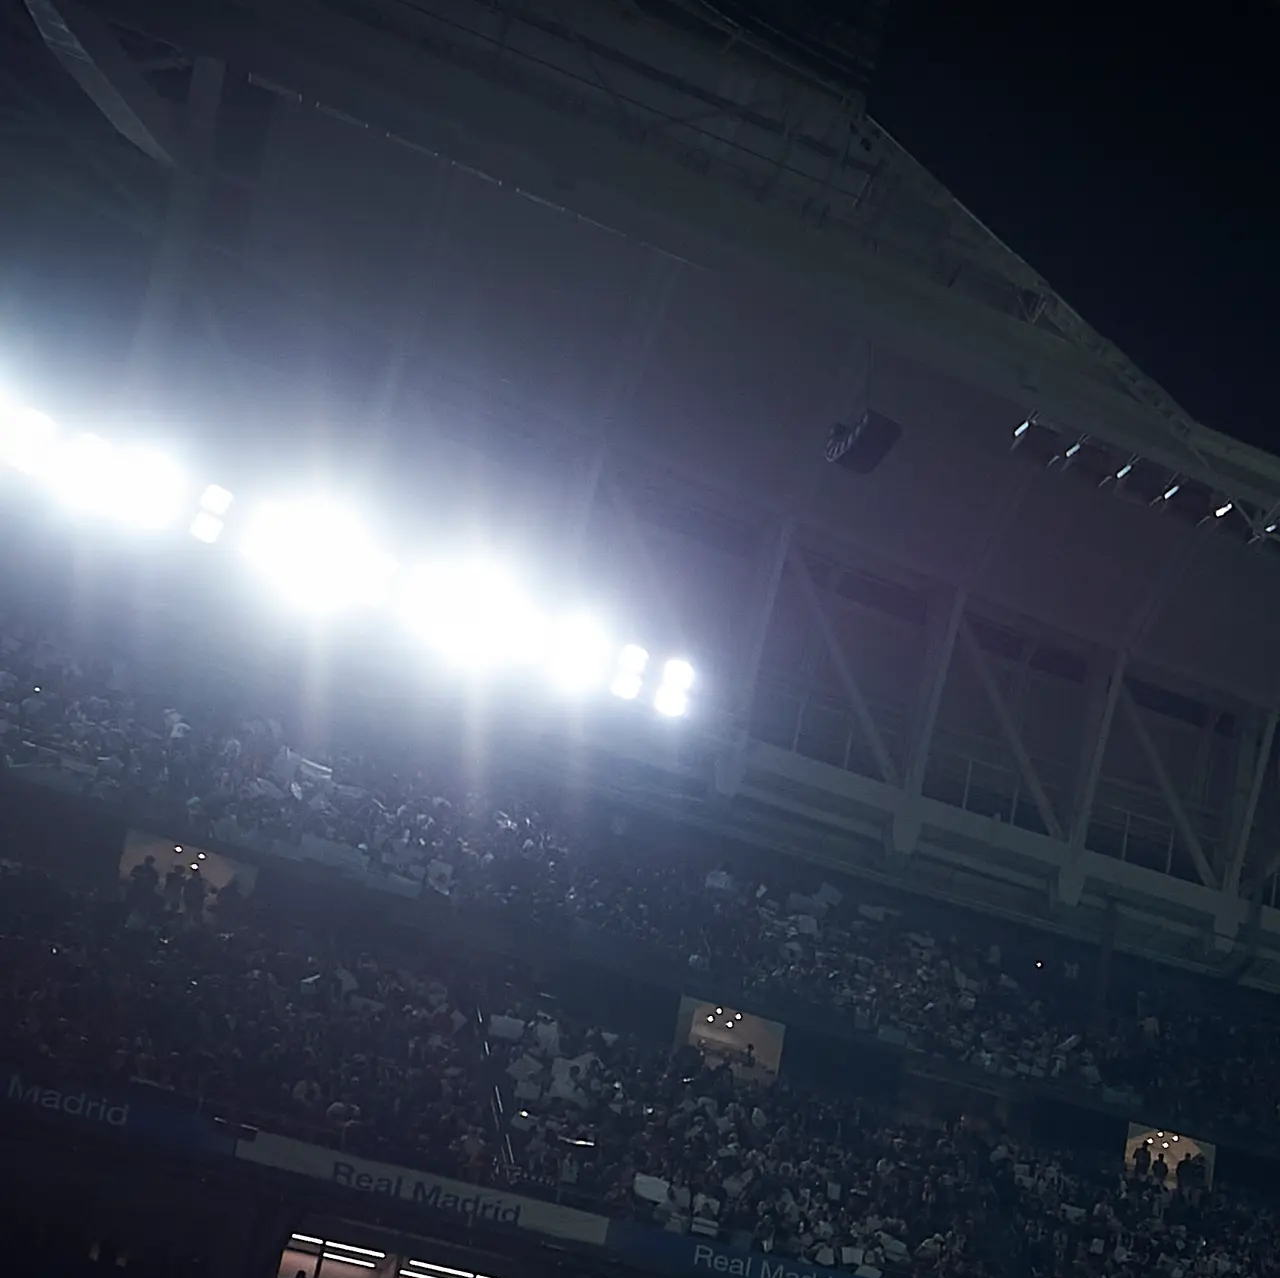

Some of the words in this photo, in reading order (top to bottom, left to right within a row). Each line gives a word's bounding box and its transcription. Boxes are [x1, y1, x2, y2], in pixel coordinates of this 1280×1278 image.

[6, 1073, 130, 1126] Madrid
[333, 1161, 402, 1198] Real
[413, 1181, 521, 1227] Madrid
[693, 1244, 752, 1278] Real
